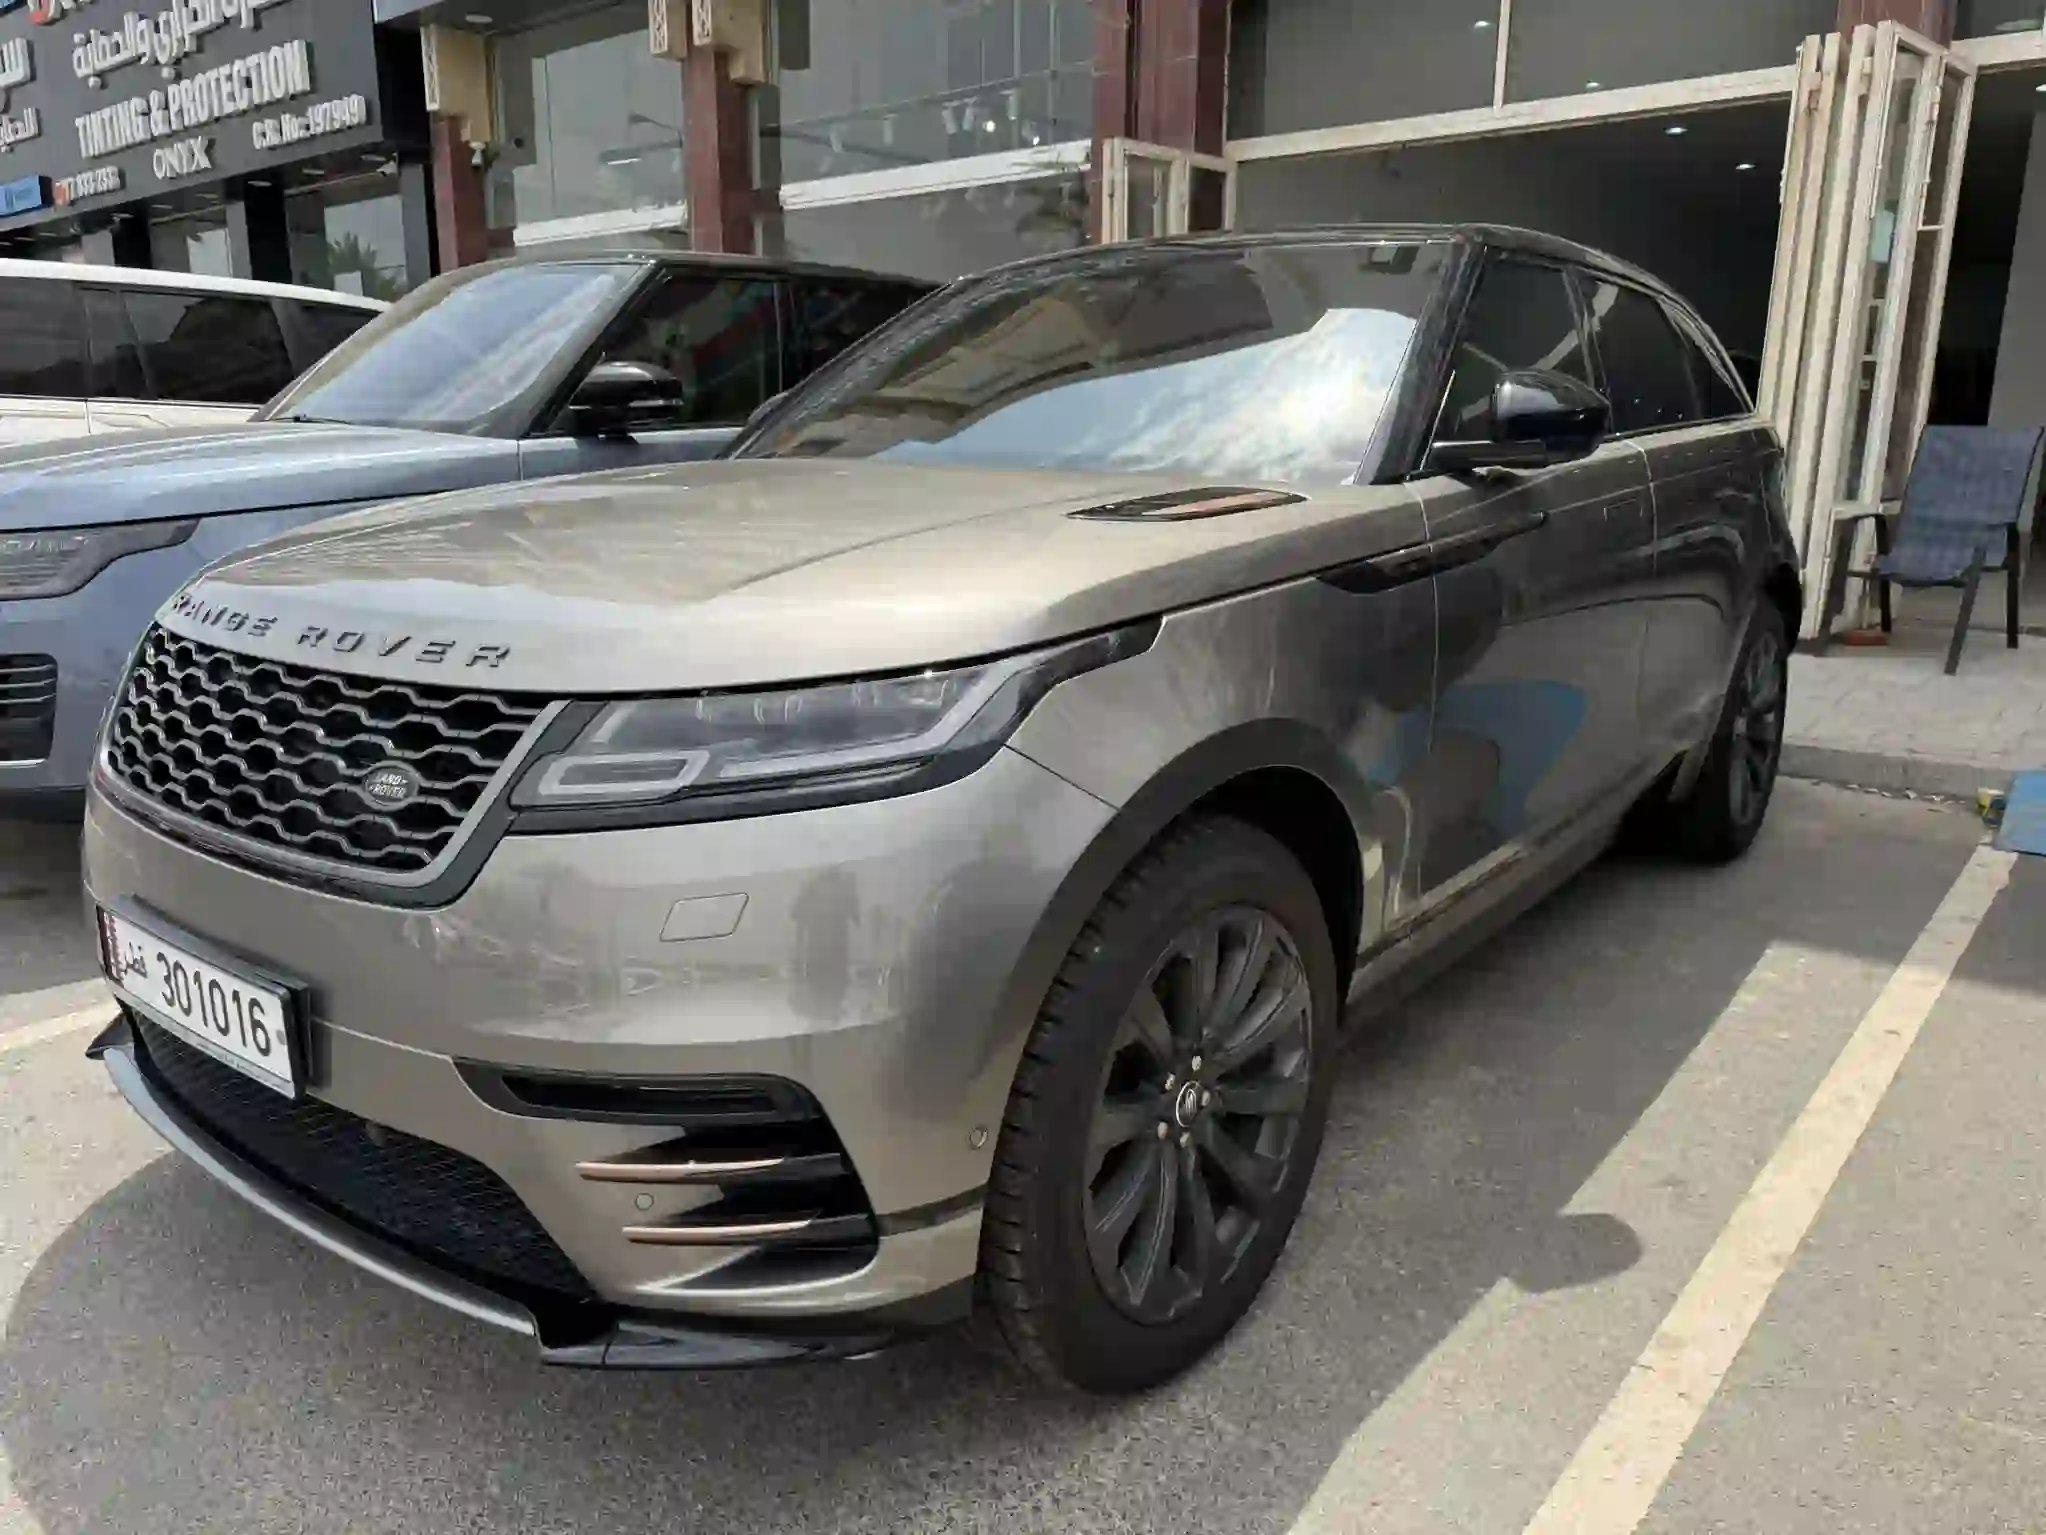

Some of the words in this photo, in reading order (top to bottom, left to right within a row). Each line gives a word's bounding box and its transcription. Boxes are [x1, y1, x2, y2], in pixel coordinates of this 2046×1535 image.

[75, 96, 148, 159] TINTING
[150, 90, 170, 137] &
[168, 39, 311, 131] PROTECTION
[153, 136, 212, 180] ONYX
[173, 594, 278, 637] RANGE
[297, 625, 511, 668] ROVER
[156, 951, 271, 1057] 301016
